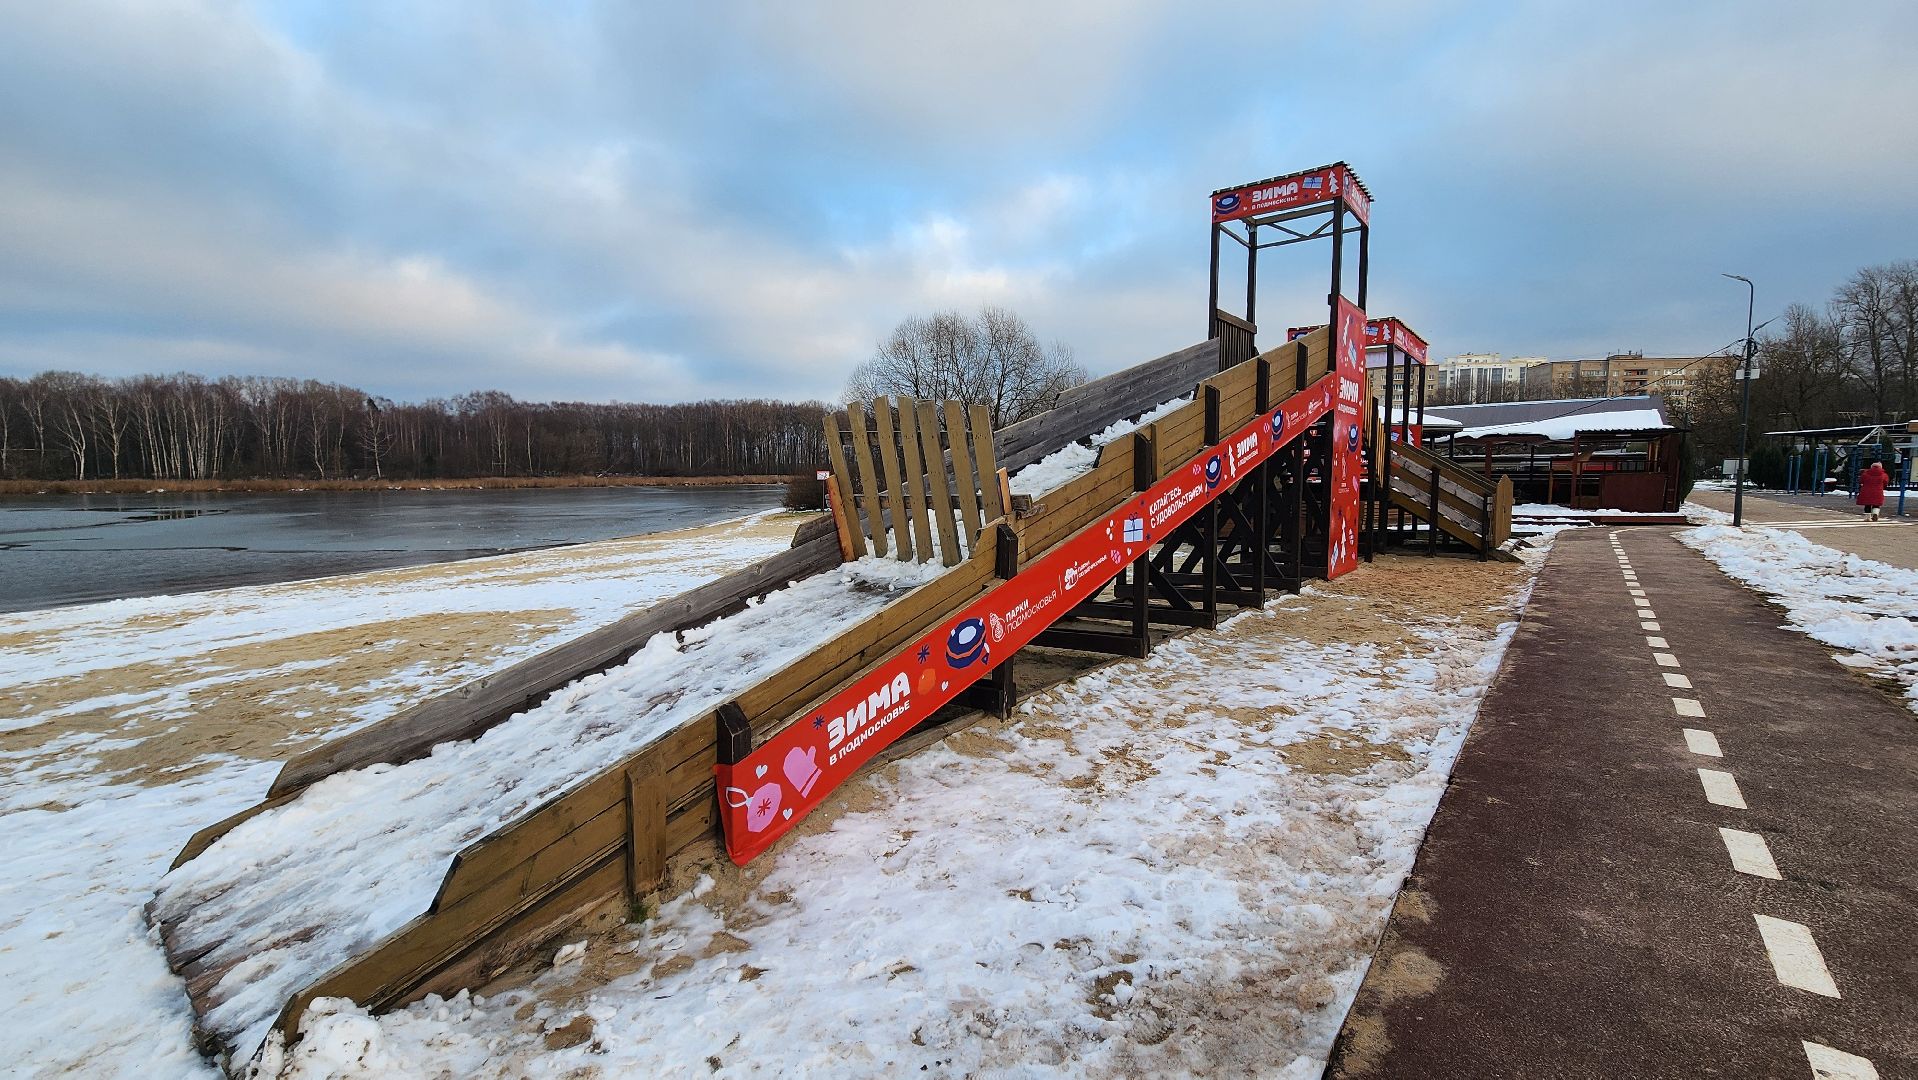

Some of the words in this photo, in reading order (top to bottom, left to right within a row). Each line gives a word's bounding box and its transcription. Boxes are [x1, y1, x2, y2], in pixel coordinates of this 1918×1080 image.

[1252, 181, 1298, 203] ЗИМА
[1339, 376, 1359, 403] ЗИМА
[1237, 432, 1258, 459] ЗИМА
[1149, 486, 1182, 516] КАТАЙТЕСЬ
[1150, 517, 1156, 529] С
[1155, 483, 1204, 526] УДОВОЛЬСТВИЕМ
[1005, 599, 1029, 623] ПАРКИ
[1006, 589, 1057, 634] ПОДМОСКОВЬЯ
[827, 671, 911, 751] ЗИМА
[829, 753, 838, 766] В
[838, 699, 910, 760] ПОДМОСКОВЬЕ
